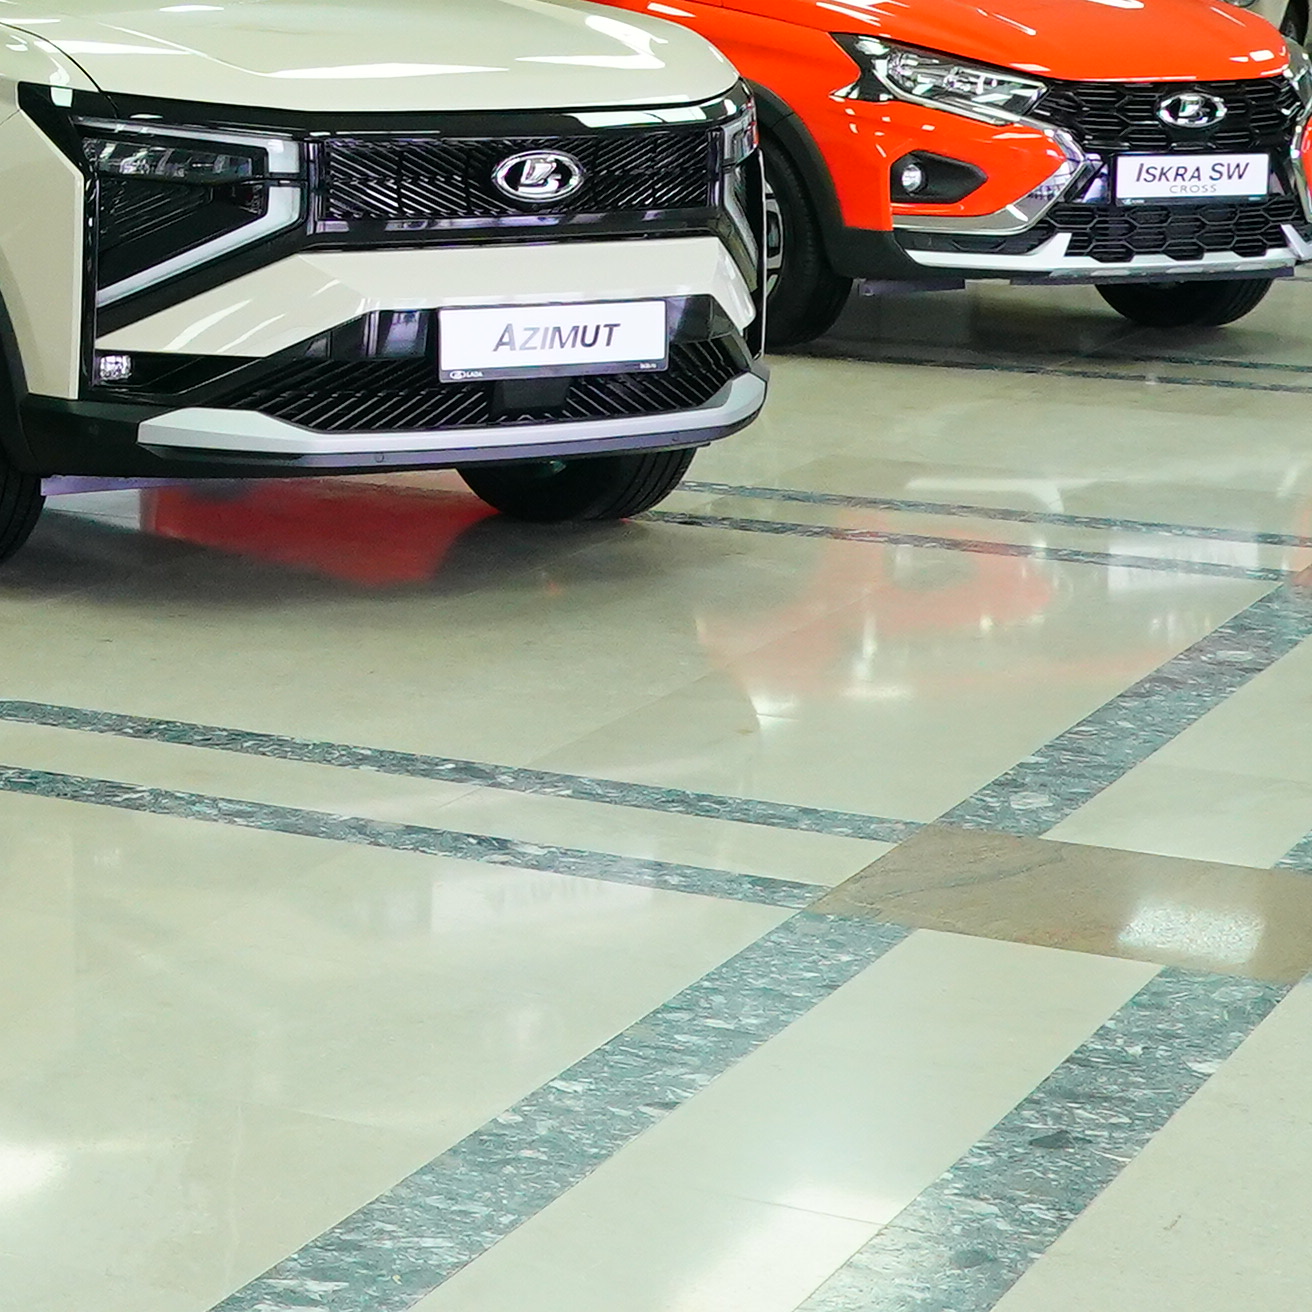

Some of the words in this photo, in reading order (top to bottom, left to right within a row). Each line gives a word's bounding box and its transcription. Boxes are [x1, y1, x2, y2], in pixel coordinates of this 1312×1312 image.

[1136, 163, 1201, 182] ISKRA
[1209, 162, 1249, 180] SW
[1169, 184, 1217, 194] CROSS
[493, 323, 621, 352] AZIMUT
